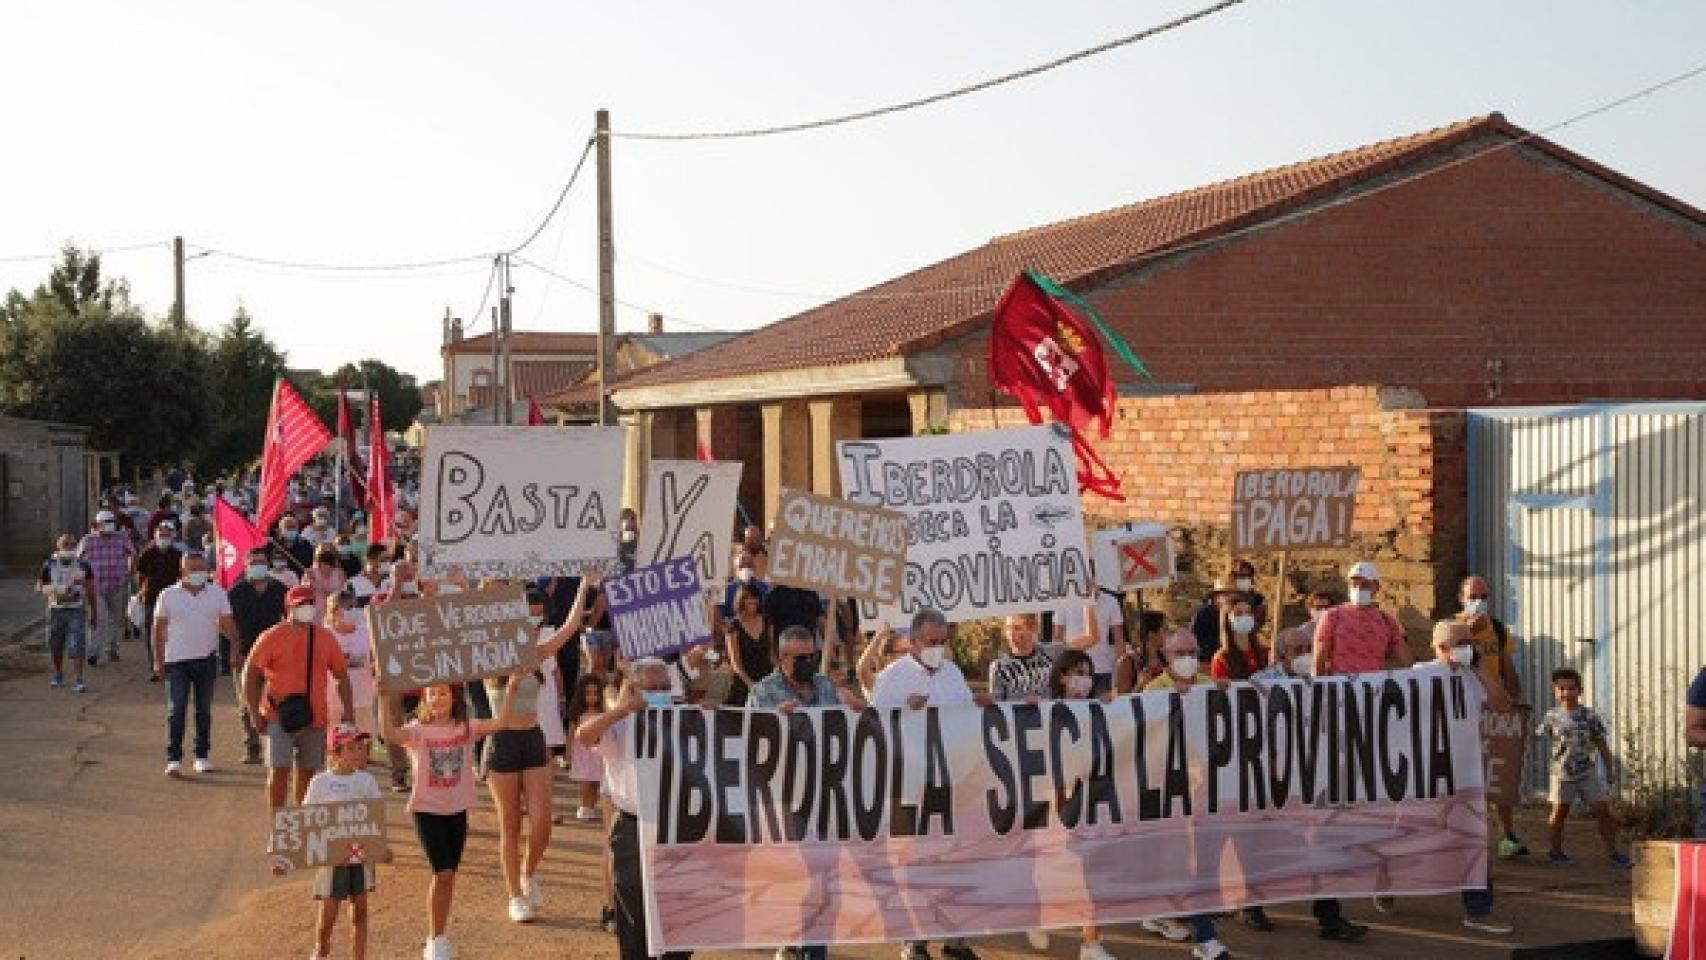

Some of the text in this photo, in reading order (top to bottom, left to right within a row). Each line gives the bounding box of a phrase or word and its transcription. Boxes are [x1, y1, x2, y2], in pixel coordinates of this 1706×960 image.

[435, 450, 607, 545] BASTA
[841, 442, 1070, 507] IBERDROLA
[1236, 470, 1359, 500] IBERDROLA
[980, 499, 1019, 535] LA
[605, 560, 695, 606] ESTO ES
[772, 539, 898, 601] EMBALSE
[410, 646, 464, 684] SIN
[634, 675, 1466, 845] "IBERDROLA SECA LA PROVINCIA"
[275, 802, 368, 830] ESTO NO
